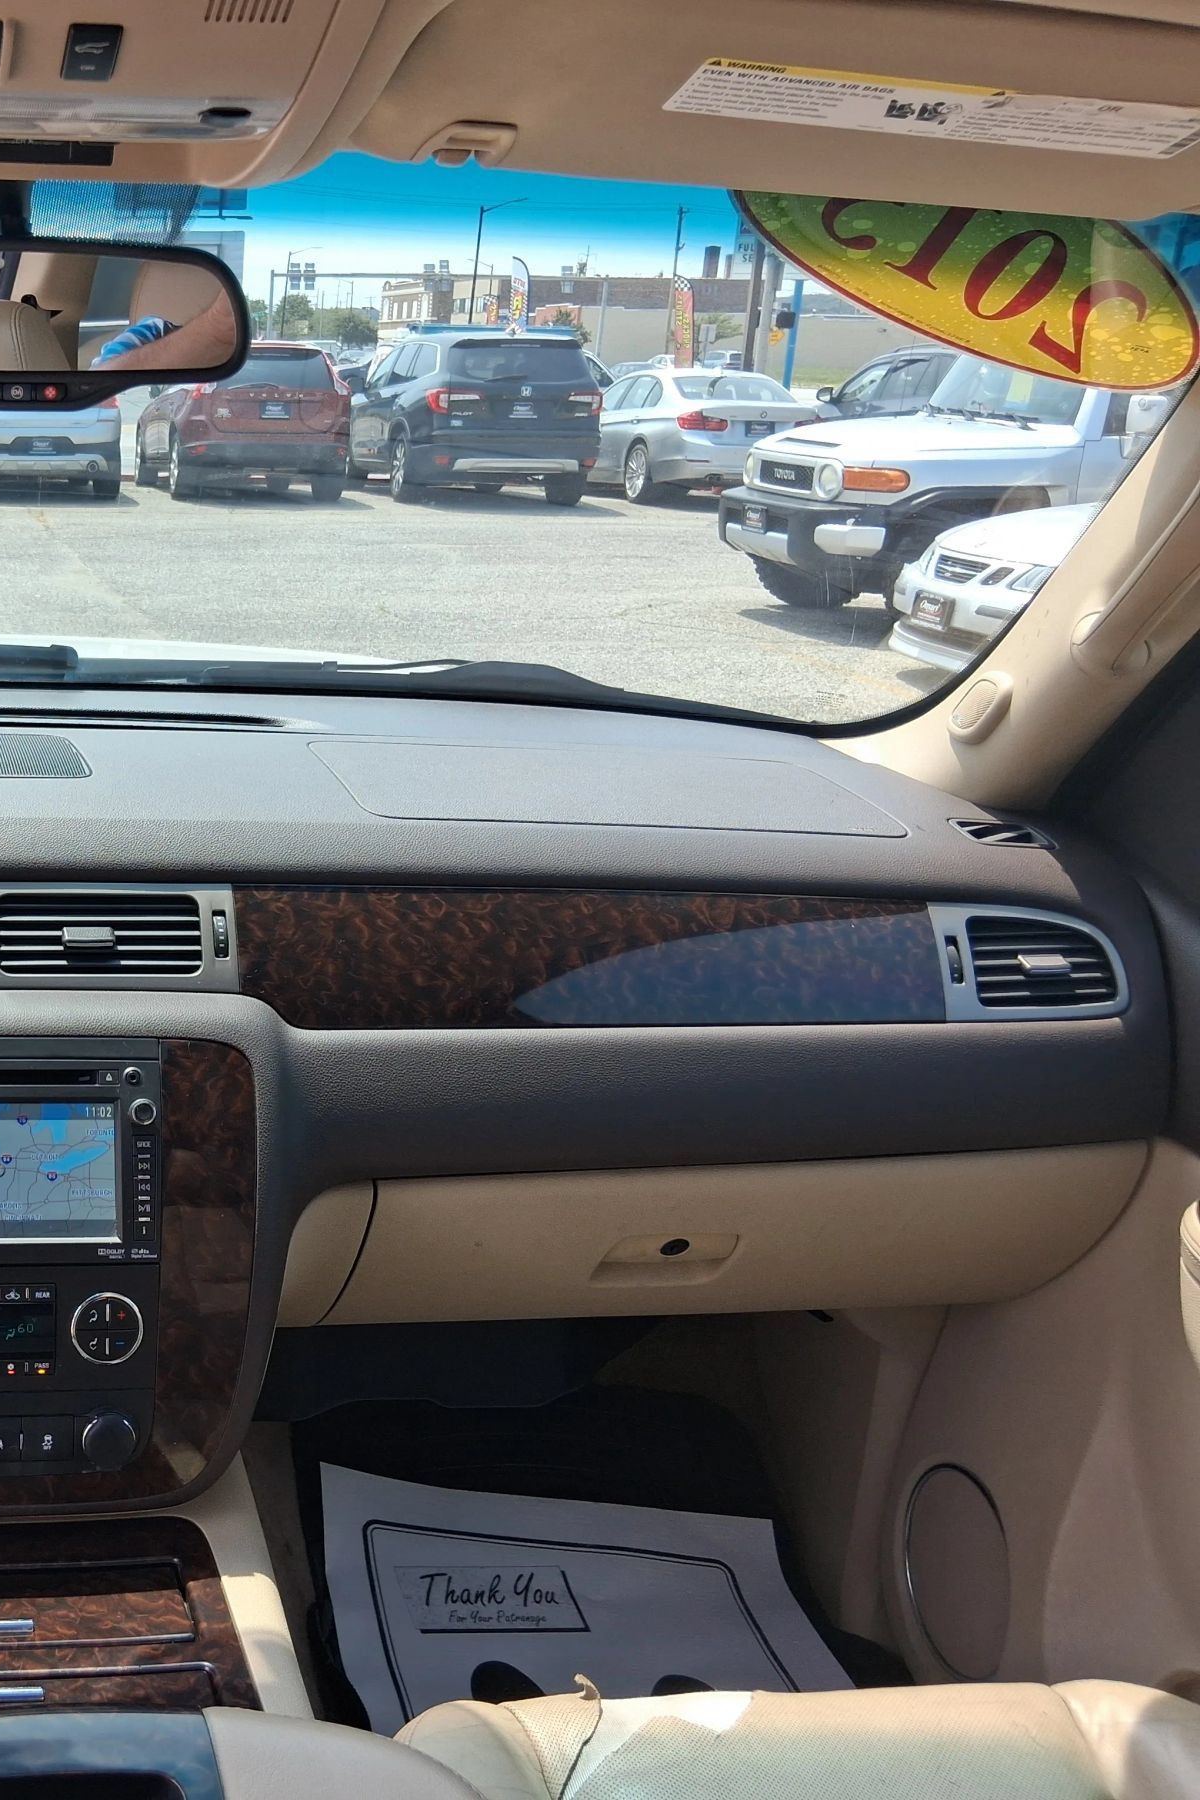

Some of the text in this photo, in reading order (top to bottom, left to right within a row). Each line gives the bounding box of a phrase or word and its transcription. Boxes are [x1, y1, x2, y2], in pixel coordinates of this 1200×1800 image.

[727, 61, 787, 74] WARNING
[702, 68, 896, 94] EVEN WITH ADVANCED AIR BAGS
[774, 468, 795, 481] TOYOTA
[85, 1106, 112, 1118] 11:02
[35, 1291, 51, 1299] REAR
[17, 1323, 34, 1334] 60
[419, 1572, 559, 1607] Thank You
[448, 1610, 547, 1627] For Your Patronage
